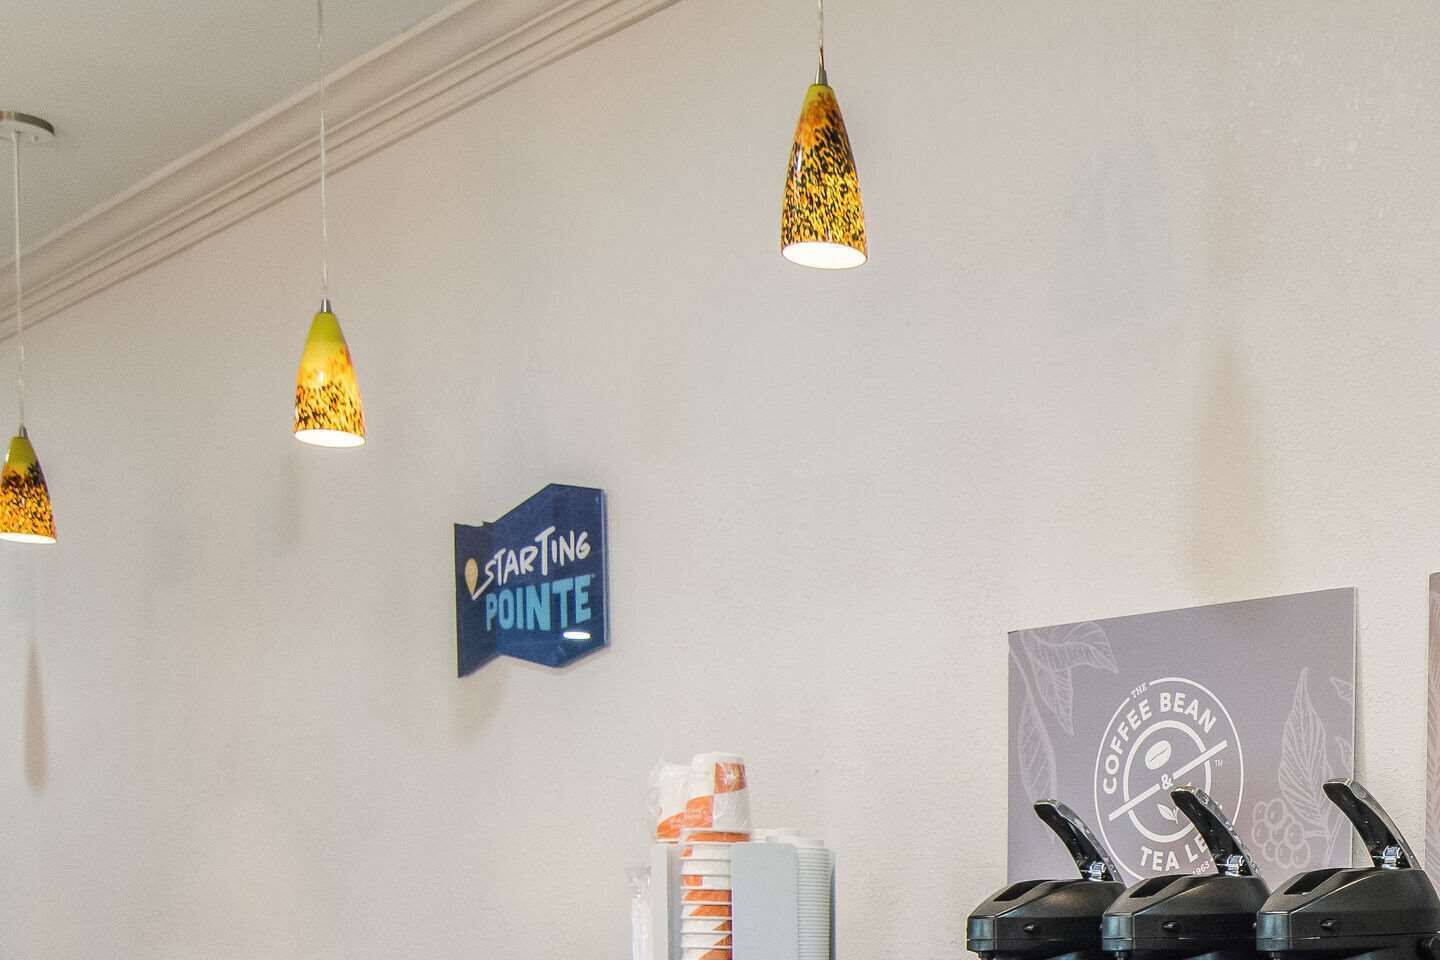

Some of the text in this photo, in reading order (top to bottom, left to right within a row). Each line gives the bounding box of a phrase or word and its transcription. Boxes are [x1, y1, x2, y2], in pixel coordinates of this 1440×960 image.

[472, 526, 591, 600] STARTING
[486, 575, 592, 632] POINTE
[1131, 682, 1148, 698] THE
[1103, 692, 1216, 794] COFFEE BEAN
[1161, 773, 1174, 790] &
[1140, 834, 1208, 872] TEA LE
